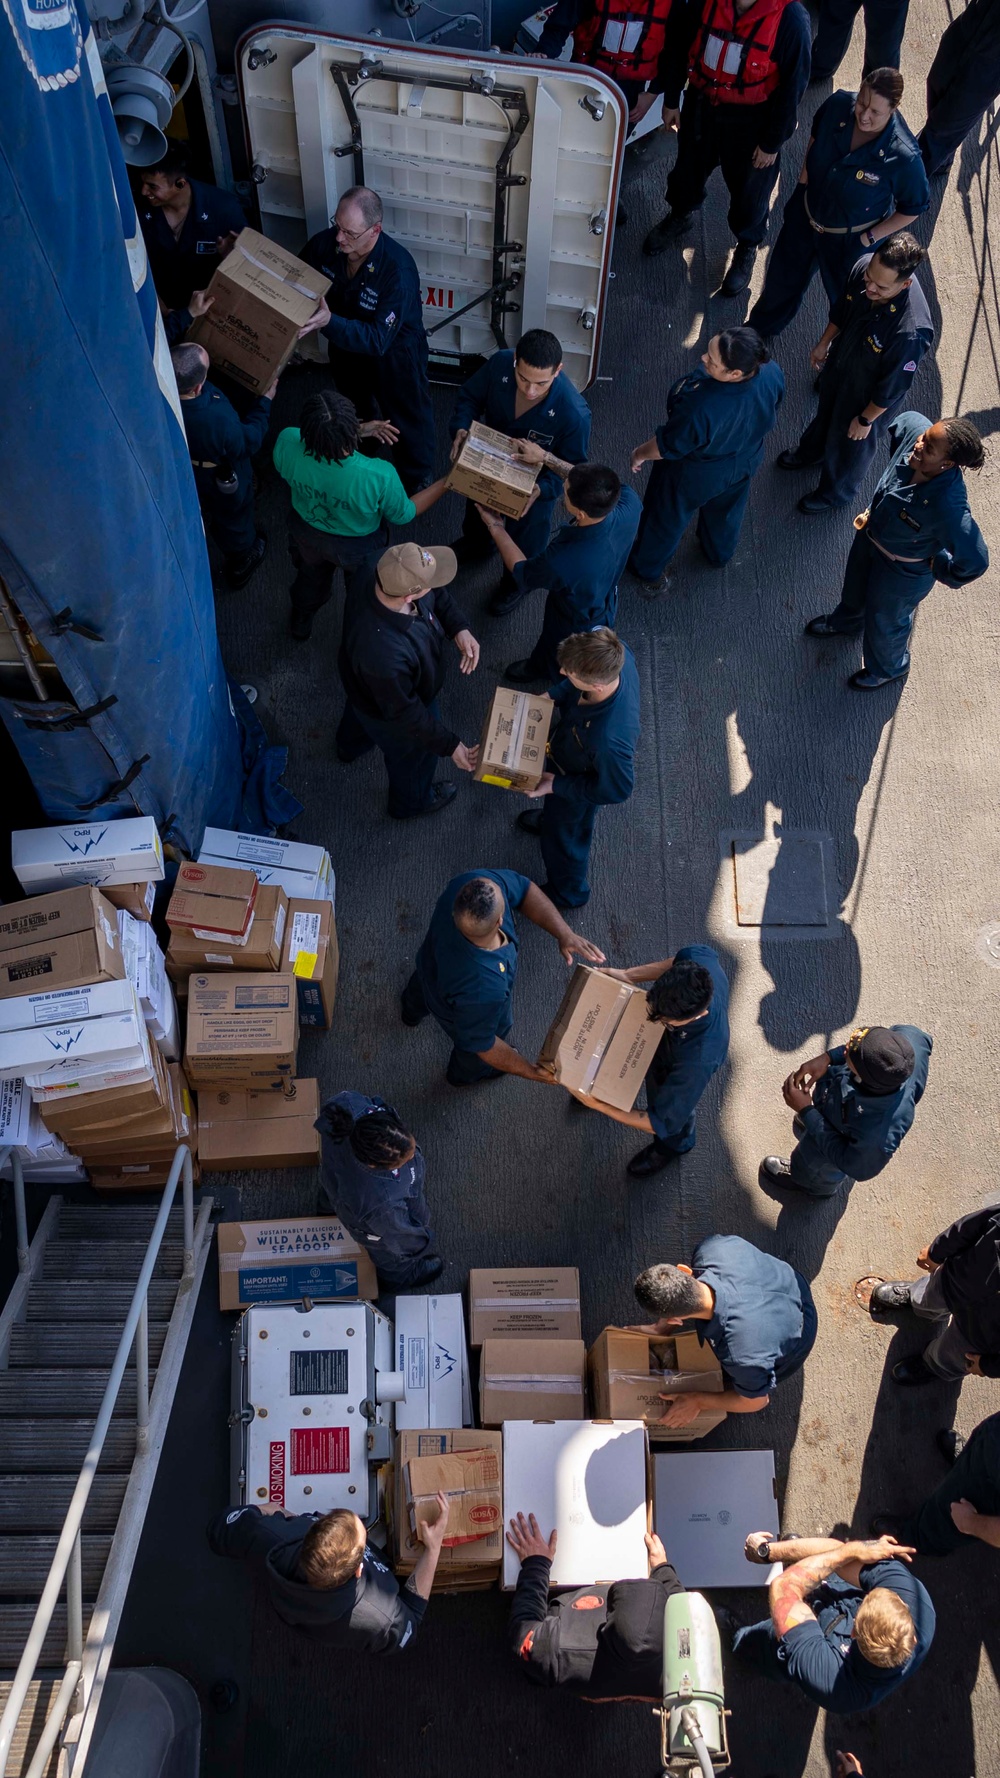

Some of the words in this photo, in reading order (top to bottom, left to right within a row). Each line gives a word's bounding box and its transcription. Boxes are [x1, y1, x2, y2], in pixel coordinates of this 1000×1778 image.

[293, 480, 327, 503] HSM
[28, 914, 46, 924] FROZEN
[47, 910, 60, 920] KEEP
[27, 968, 43, 977] OUCH!
[51, 990, 79, 998] REFRIGERATED
[572, 1028, 585, 1050] ROTATE
[581, 1008, 593, 1028] STOCK
[574, 1044, 584, 1060] FIRST
[585, 1015, 595, 1032] FIRST
[593, 1003, 601, 1016] OUT
[633, 1038, 647, 1059] BELOW
[618, 1062, 628, 1079] KEEP
[624, 1039, 638, 1063] FROZEN
[634, 1032, 641, 1041] AT
[630, 1058, 638, 1068] OR
[260, 1227, 303, 1235] SUSTAINABLY
[256, 1236, 288, 1245] WILD
[295, 1232, 344, 1242] ALASKA
[272, 1242, 330, 1253] SEAFOOD
[243, 1275, 288, 1284] IMPORTANT:
[271, 1444, 283, 1490] SMOKING
[470, 1508, 494, 1519] Tyson
